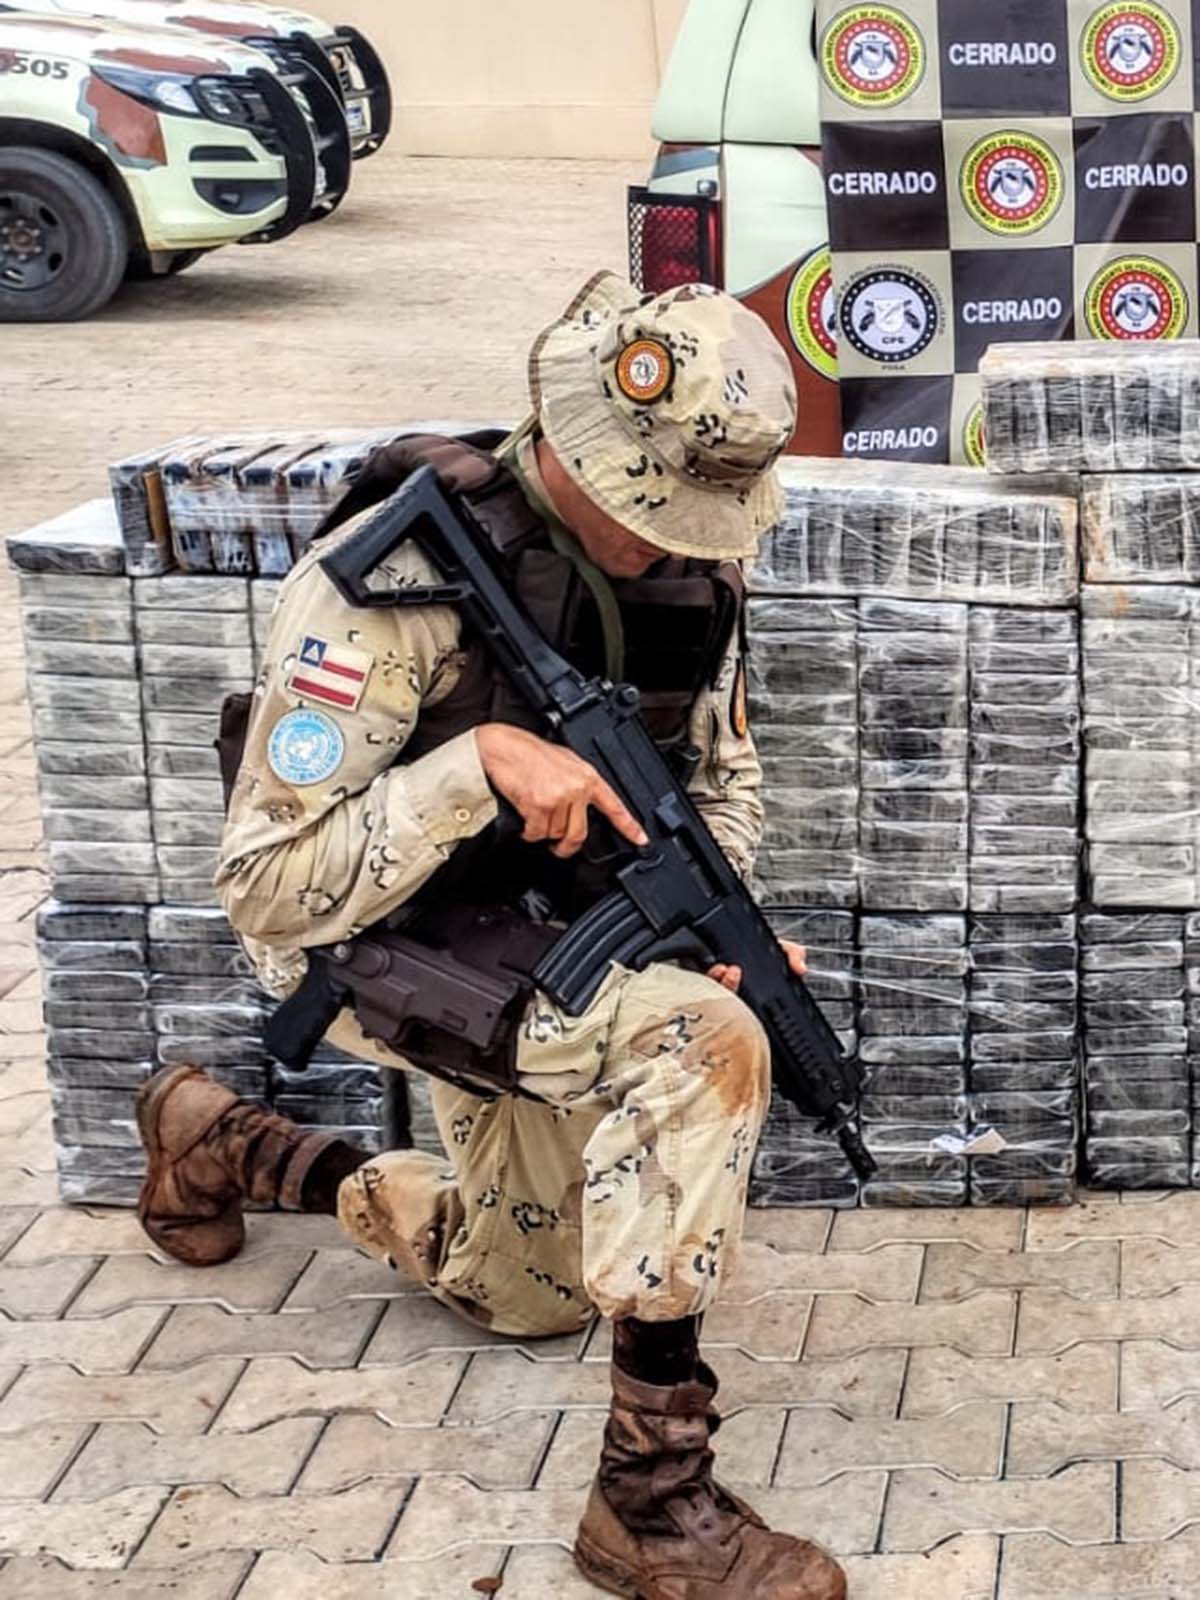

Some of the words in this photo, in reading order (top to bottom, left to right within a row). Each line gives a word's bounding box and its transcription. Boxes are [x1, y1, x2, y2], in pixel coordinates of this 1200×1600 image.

[949, 43, 1056, 65] CERRADO
[829, 172, 936, 194] CERRADO
[1085, 164, 1187, 188] CERRADO
[963, 298, 1061, 323] CERRADO
[843, 426, 938, 452] CERRADO
